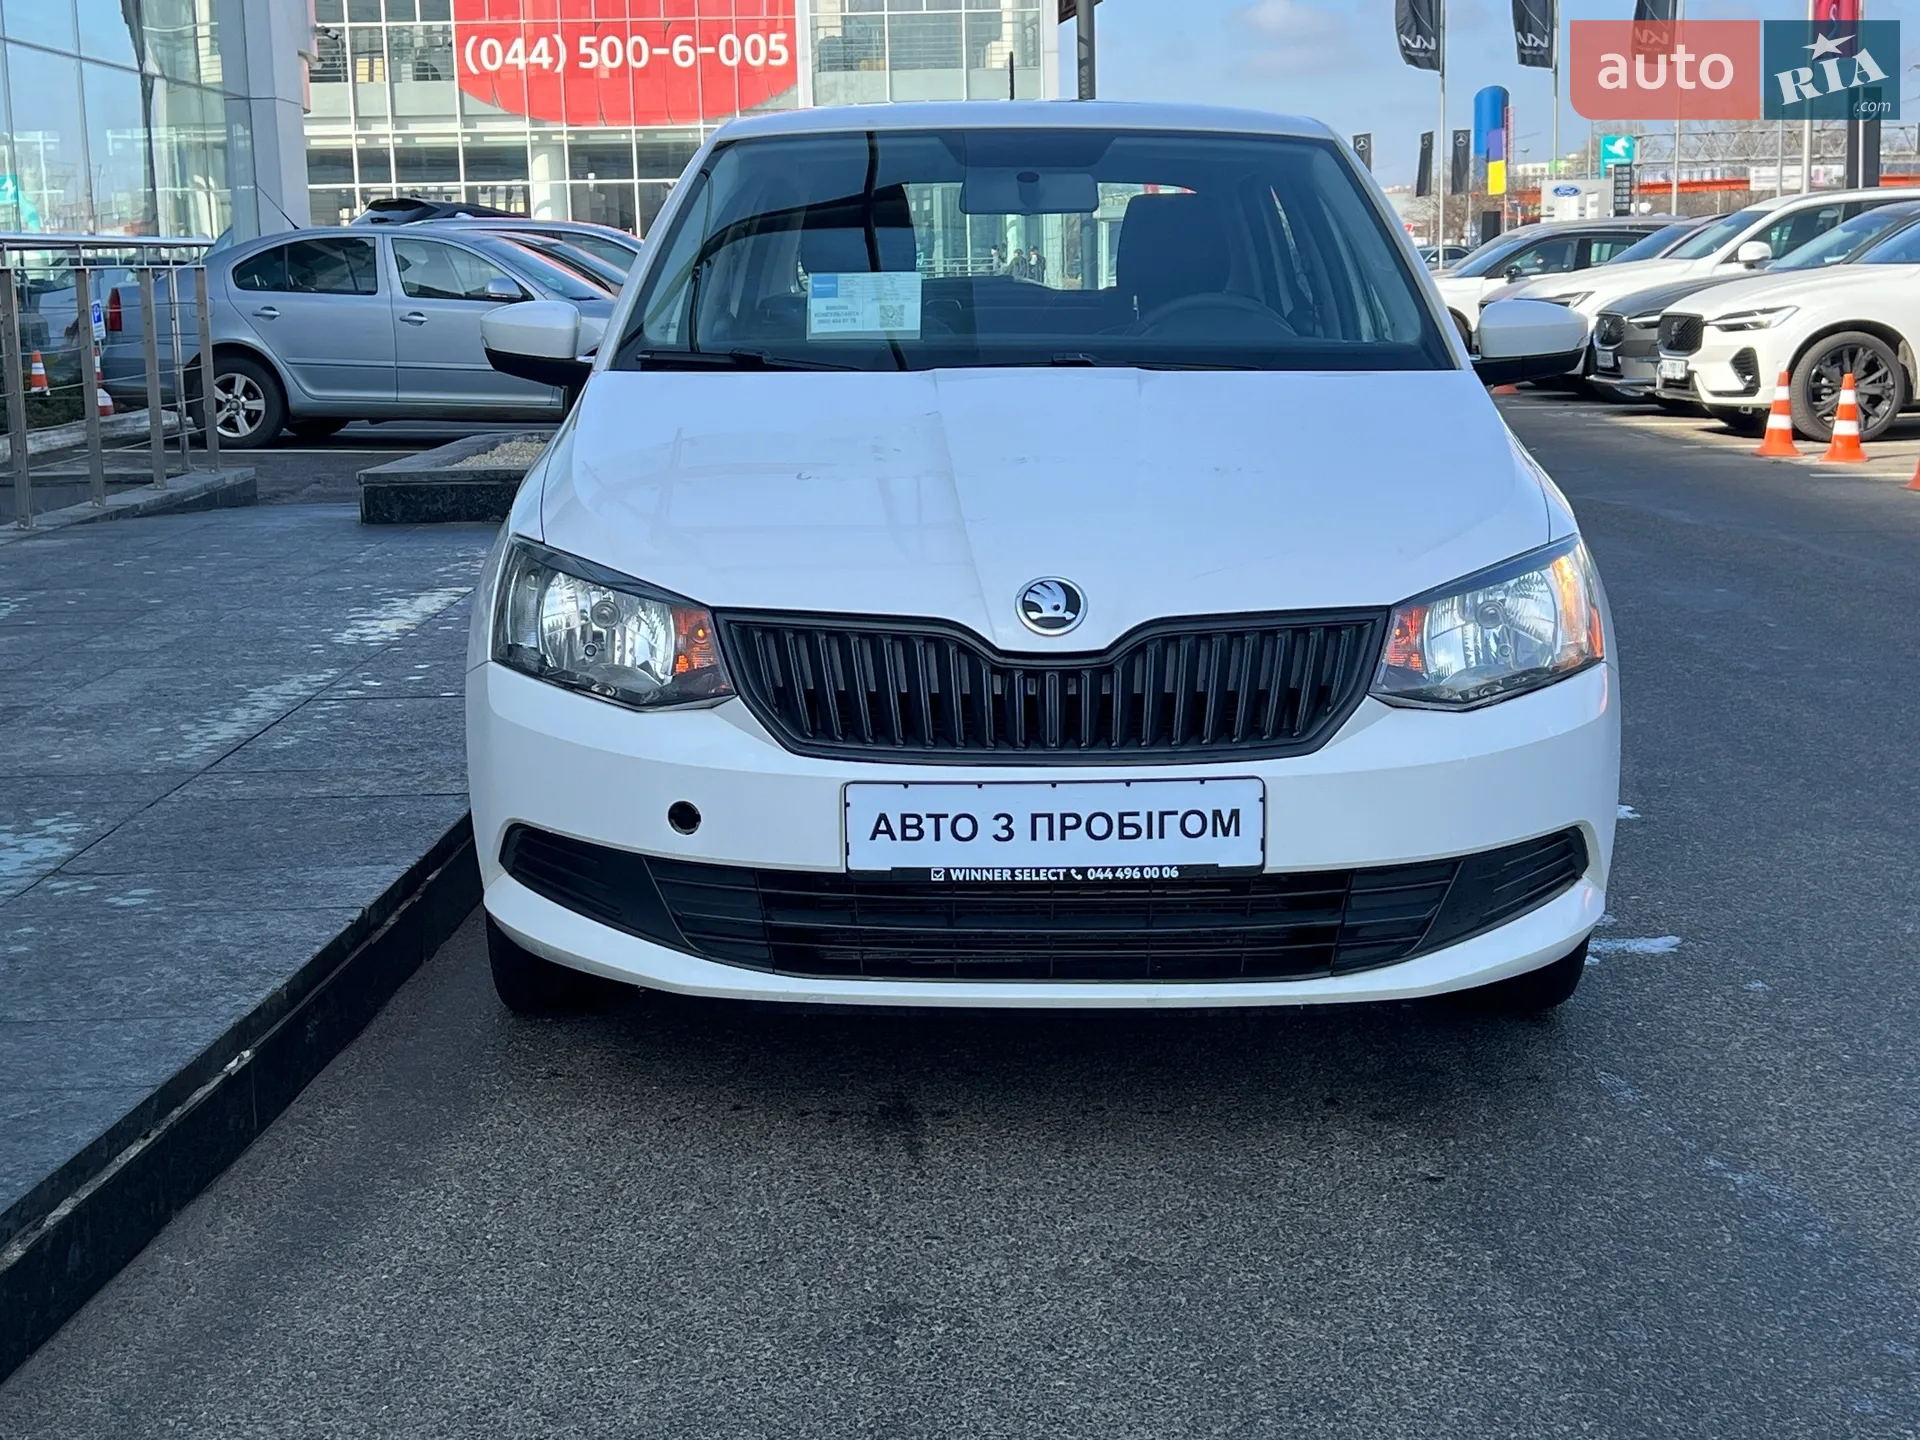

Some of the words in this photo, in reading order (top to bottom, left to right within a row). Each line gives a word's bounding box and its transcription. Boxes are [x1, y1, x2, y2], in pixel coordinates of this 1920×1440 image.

[464, 34, 567, 74] (044)
[578, 33, 788, 69] 500-6-005
[869, 812, 979, 842] АВТО
[1030, 808, 1241, 842] ПРОБІГОМ
[950, 868, 1012, 881] WINNER
[1014, 868, 1067, 881] SELECT
[1087, 868, 1113, 880] 044
[1115, 867, 1141, 880] 496
[1143, 867, 1160, 879] 00
[1162, 866, 1179, 879] 06
